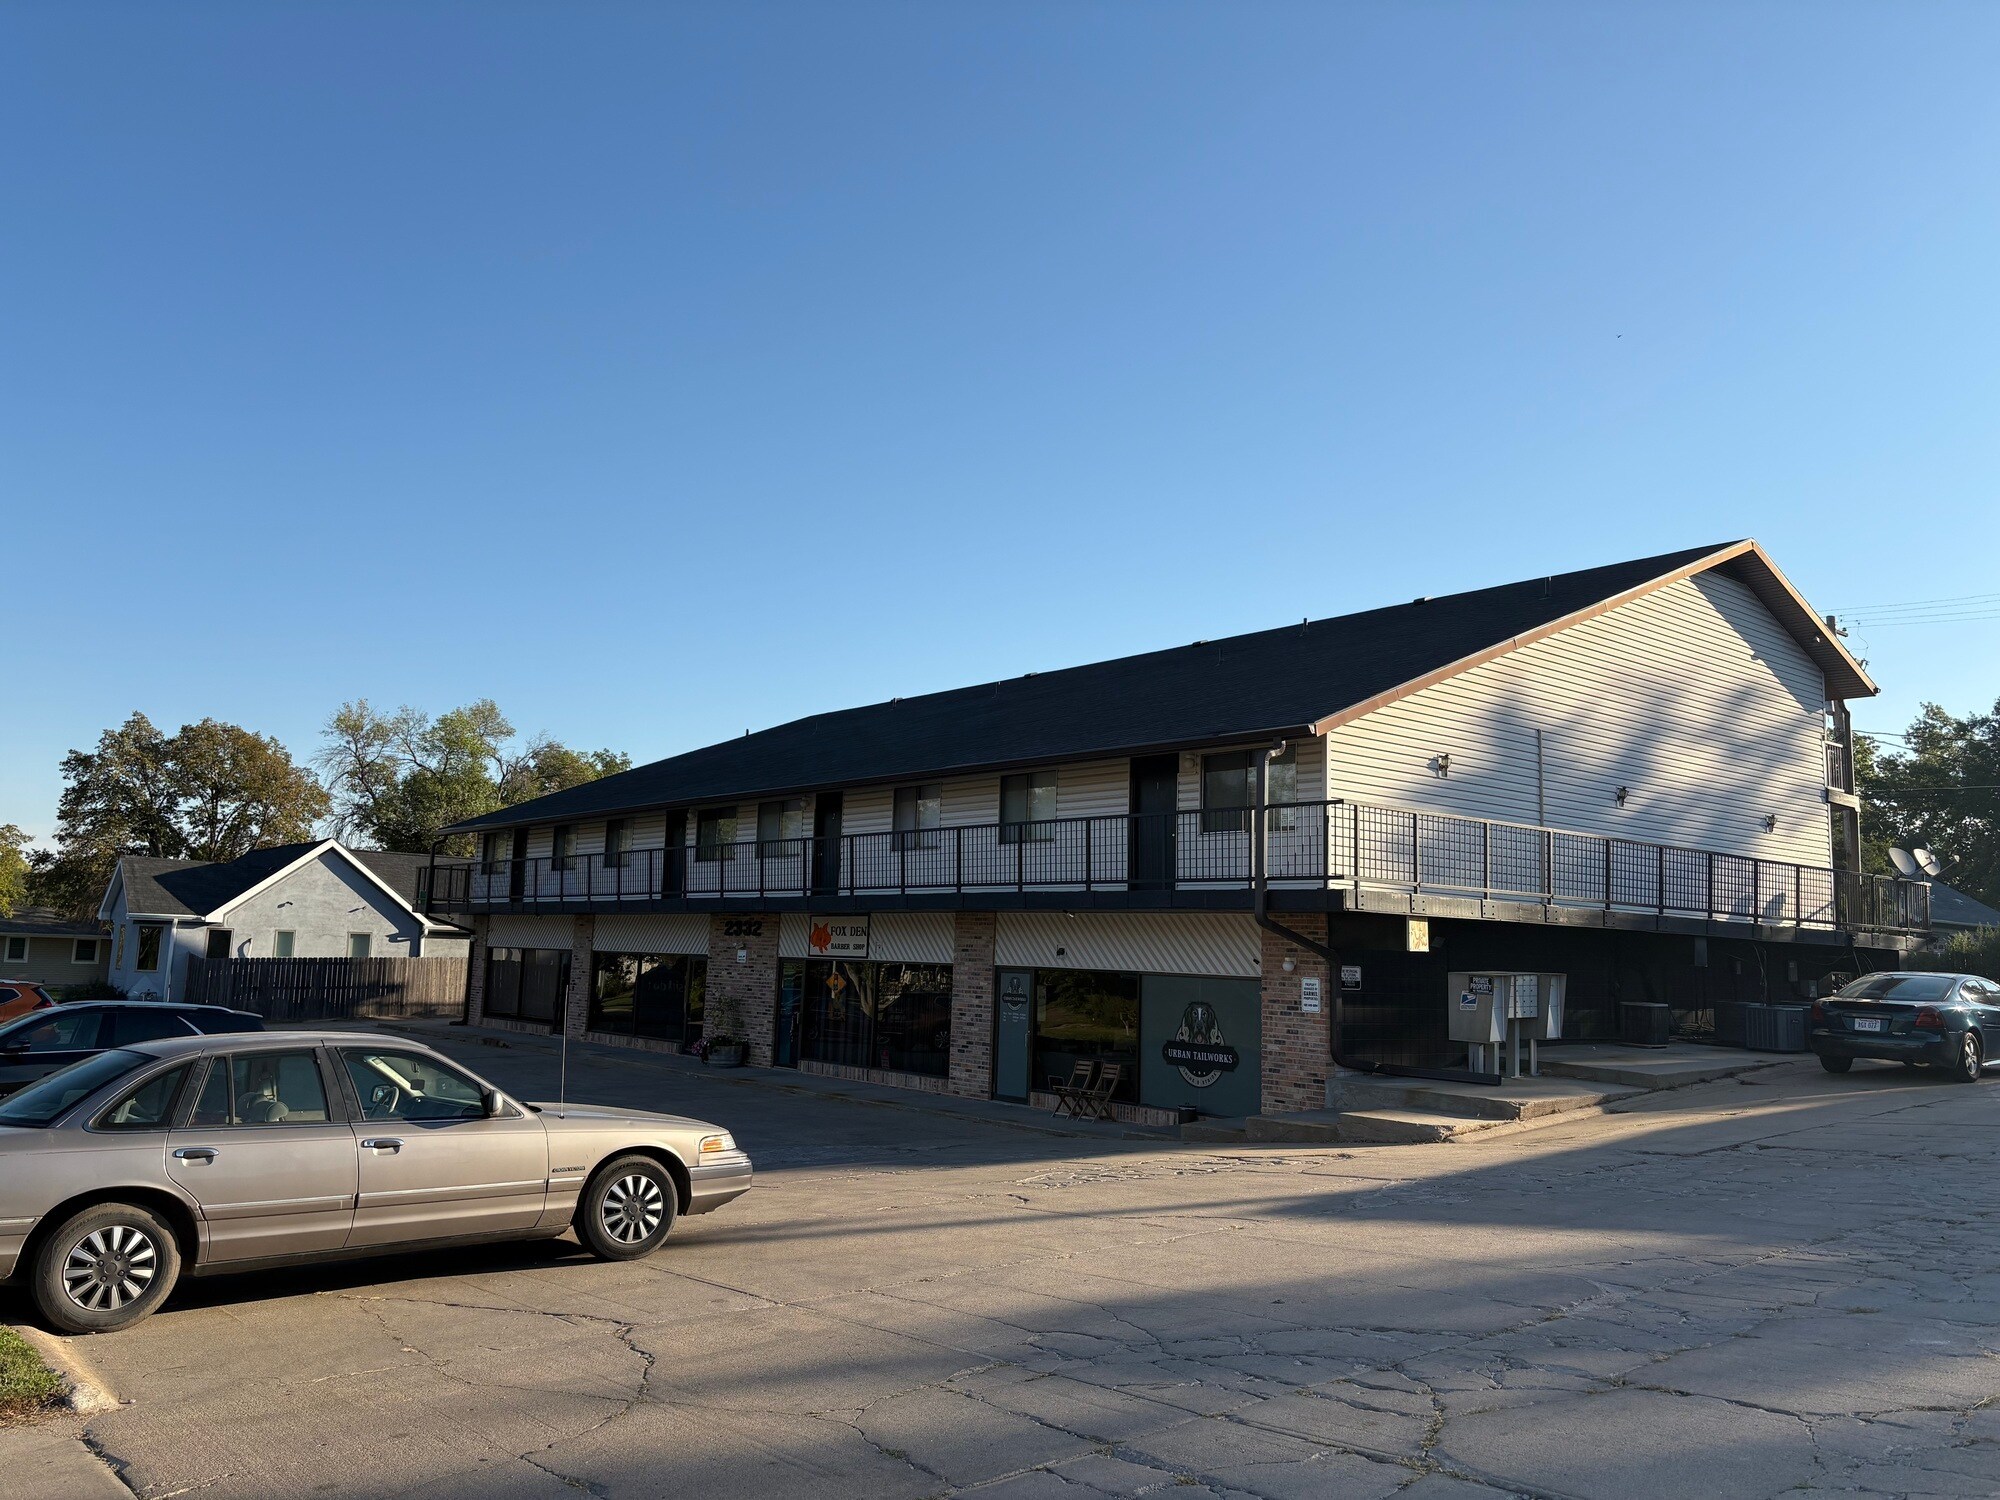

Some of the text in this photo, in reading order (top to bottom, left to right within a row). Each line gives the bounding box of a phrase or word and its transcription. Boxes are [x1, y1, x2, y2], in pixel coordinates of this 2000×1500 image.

[831, 926, 868, 937] FOX DEN
[1168, 1048, 1233, 1064] URBAN TAILWORKS
